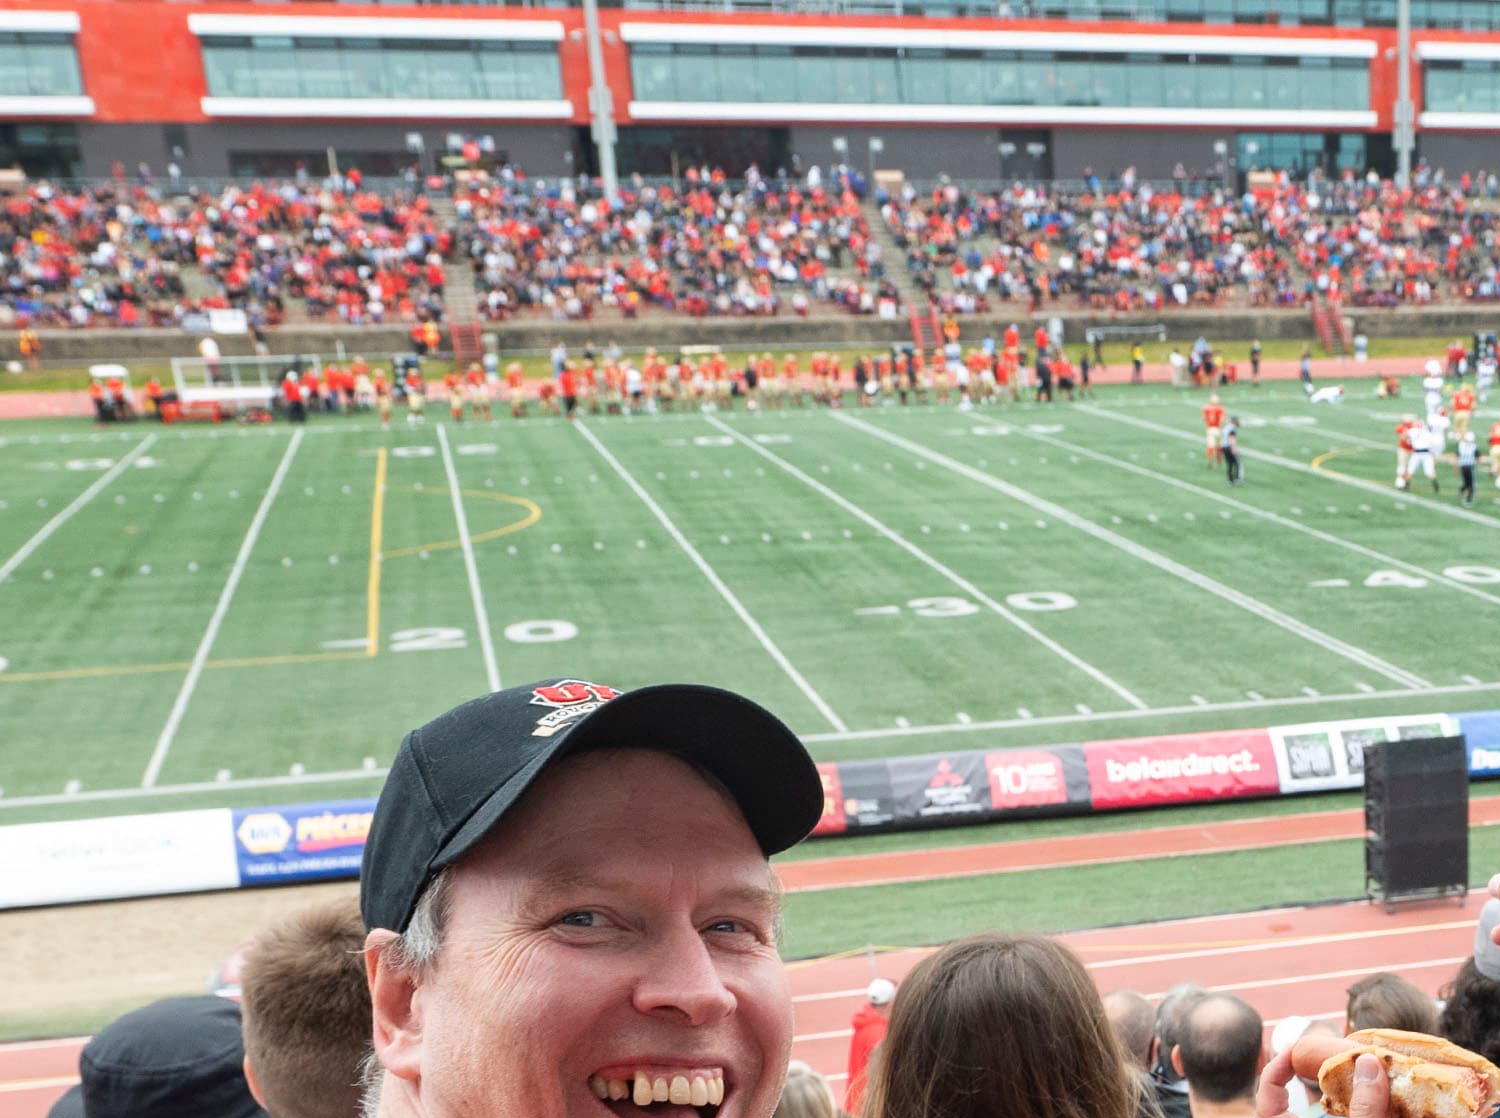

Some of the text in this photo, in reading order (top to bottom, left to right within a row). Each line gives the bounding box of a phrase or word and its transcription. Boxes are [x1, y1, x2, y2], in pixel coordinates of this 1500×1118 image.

[907, 591, 1078, 617] 30
[391, 620, 579, 651] 20
[992, 763, 1029, 795] 10
